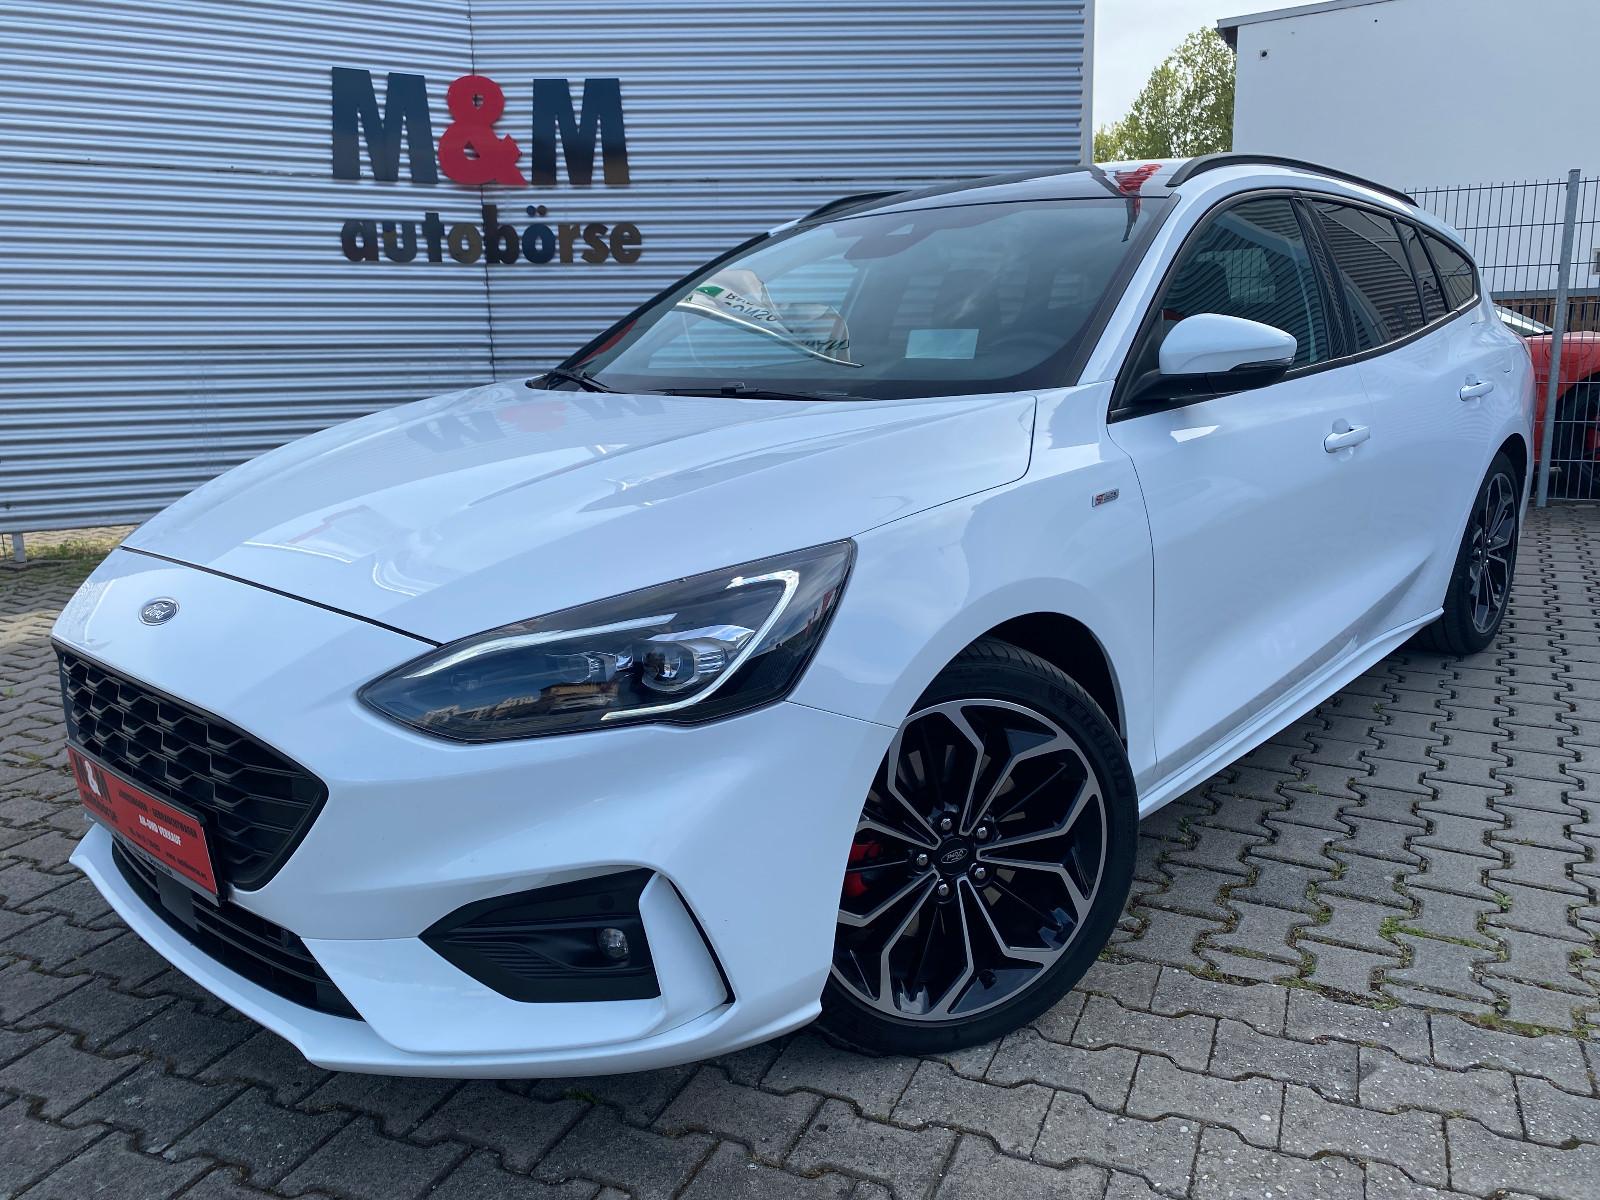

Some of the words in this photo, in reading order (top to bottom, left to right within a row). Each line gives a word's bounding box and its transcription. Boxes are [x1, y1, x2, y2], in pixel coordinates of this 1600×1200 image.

[332, 67, 630, 185] M&M
[341, 204, 643, 264] autobörse
[144, 602, 170, 620] Ford
